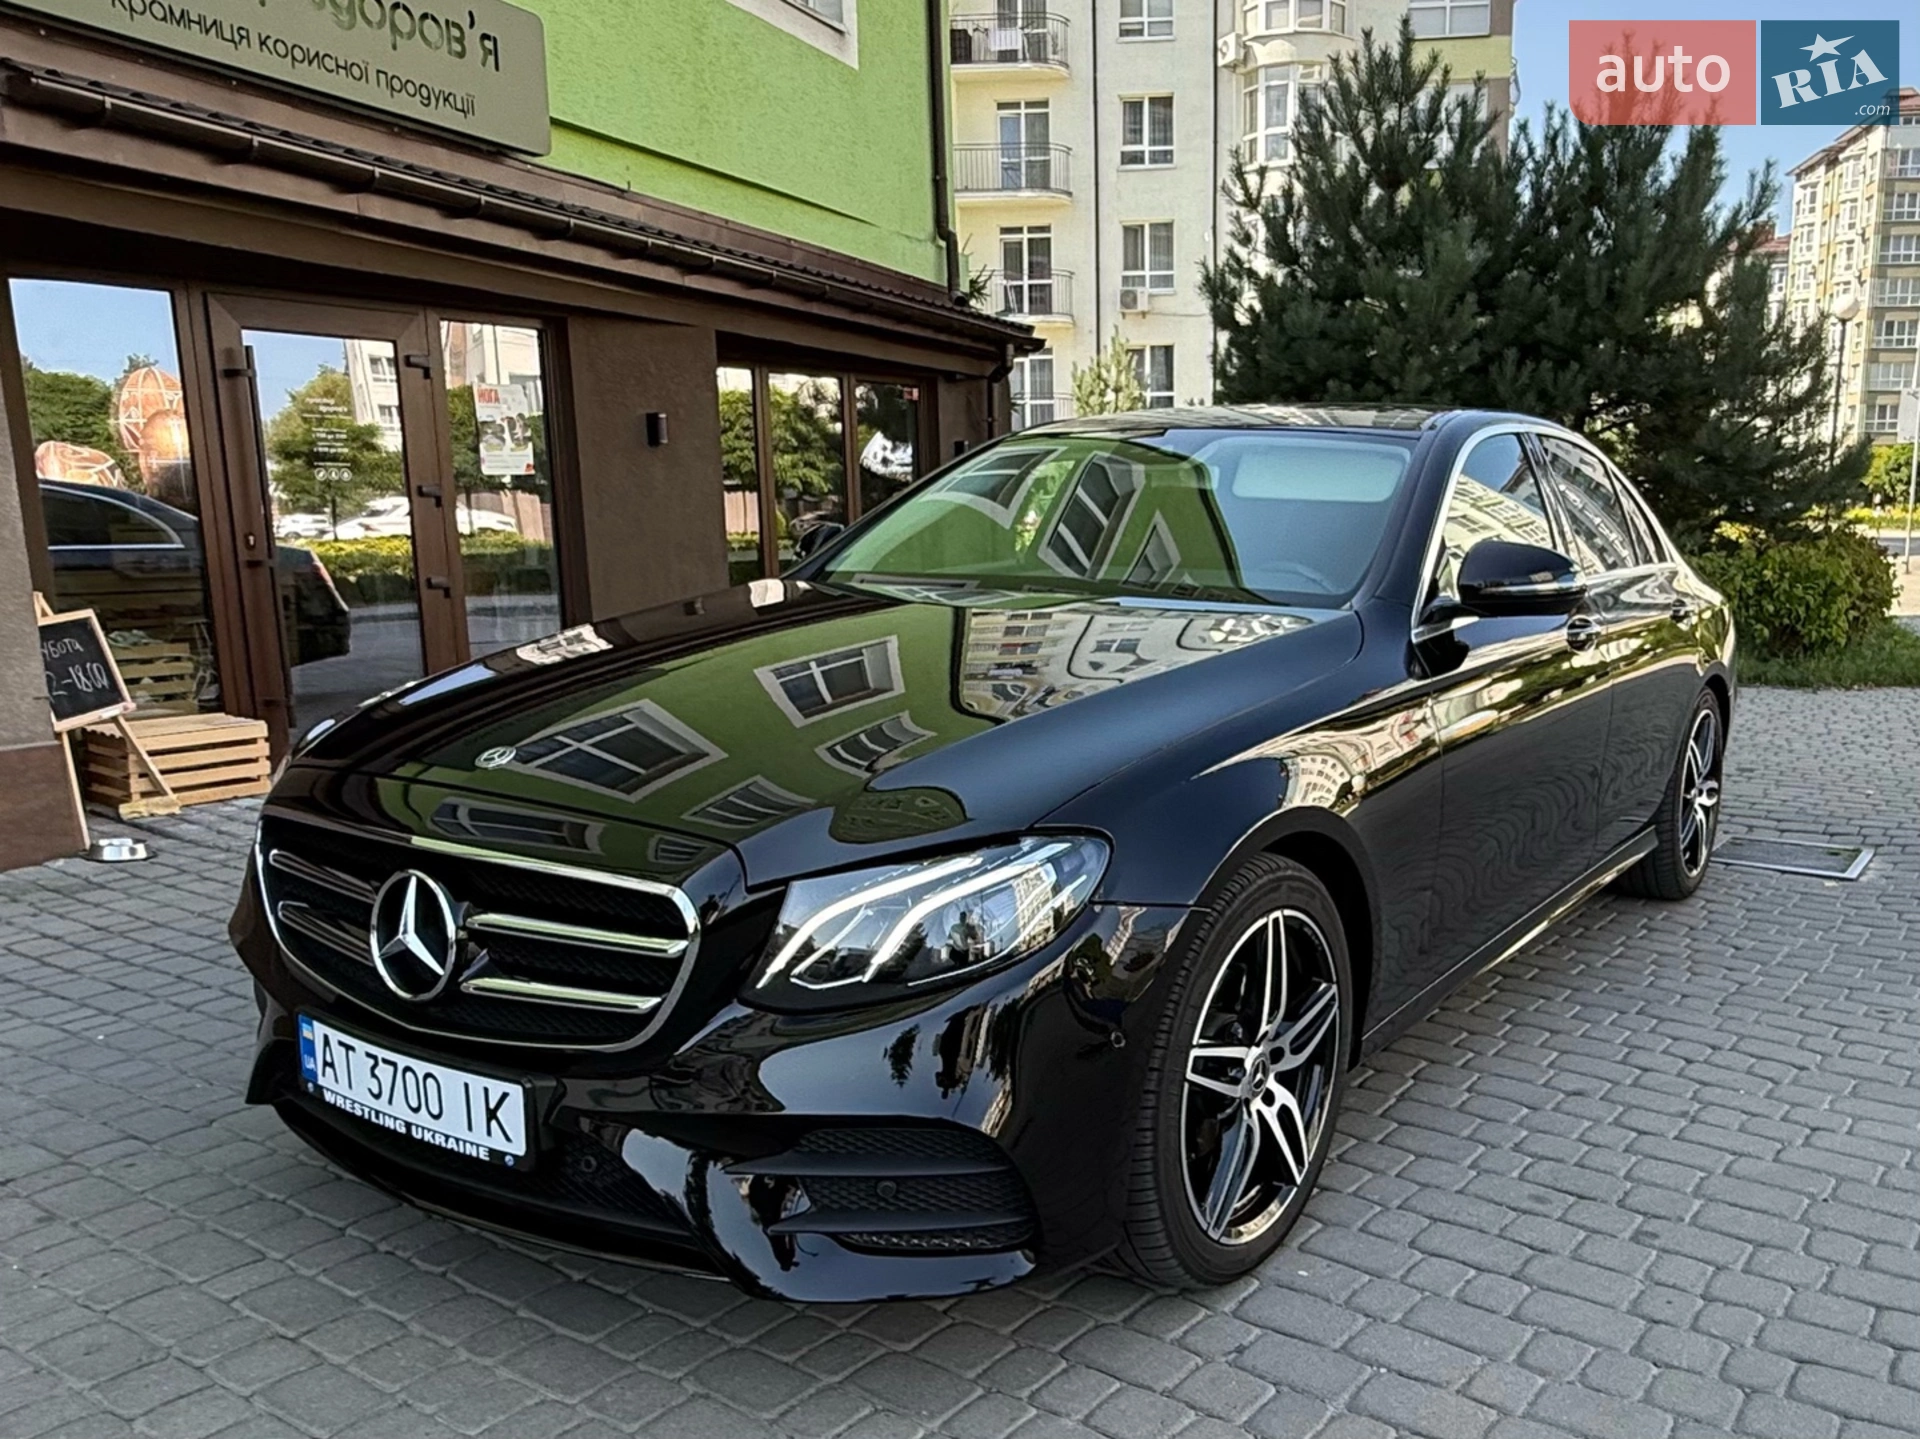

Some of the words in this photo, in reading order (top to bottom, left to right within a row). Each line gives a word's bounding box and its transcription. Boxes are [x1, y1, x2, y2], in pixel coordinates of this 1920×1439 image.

[257, 32, 370, 85] корисної
[376, 69, 476, 119] продукції
[303, 1053, 318, 1073] UA
[322, 1033, 356, 1091] AT
[364, 1051, 443, 1121] 3700
[463, 1081, 514, 1144] IK
[323, 1091, 407, 1135] WRESTLING
[411, 1124, 491, 1162] UKRAINE
